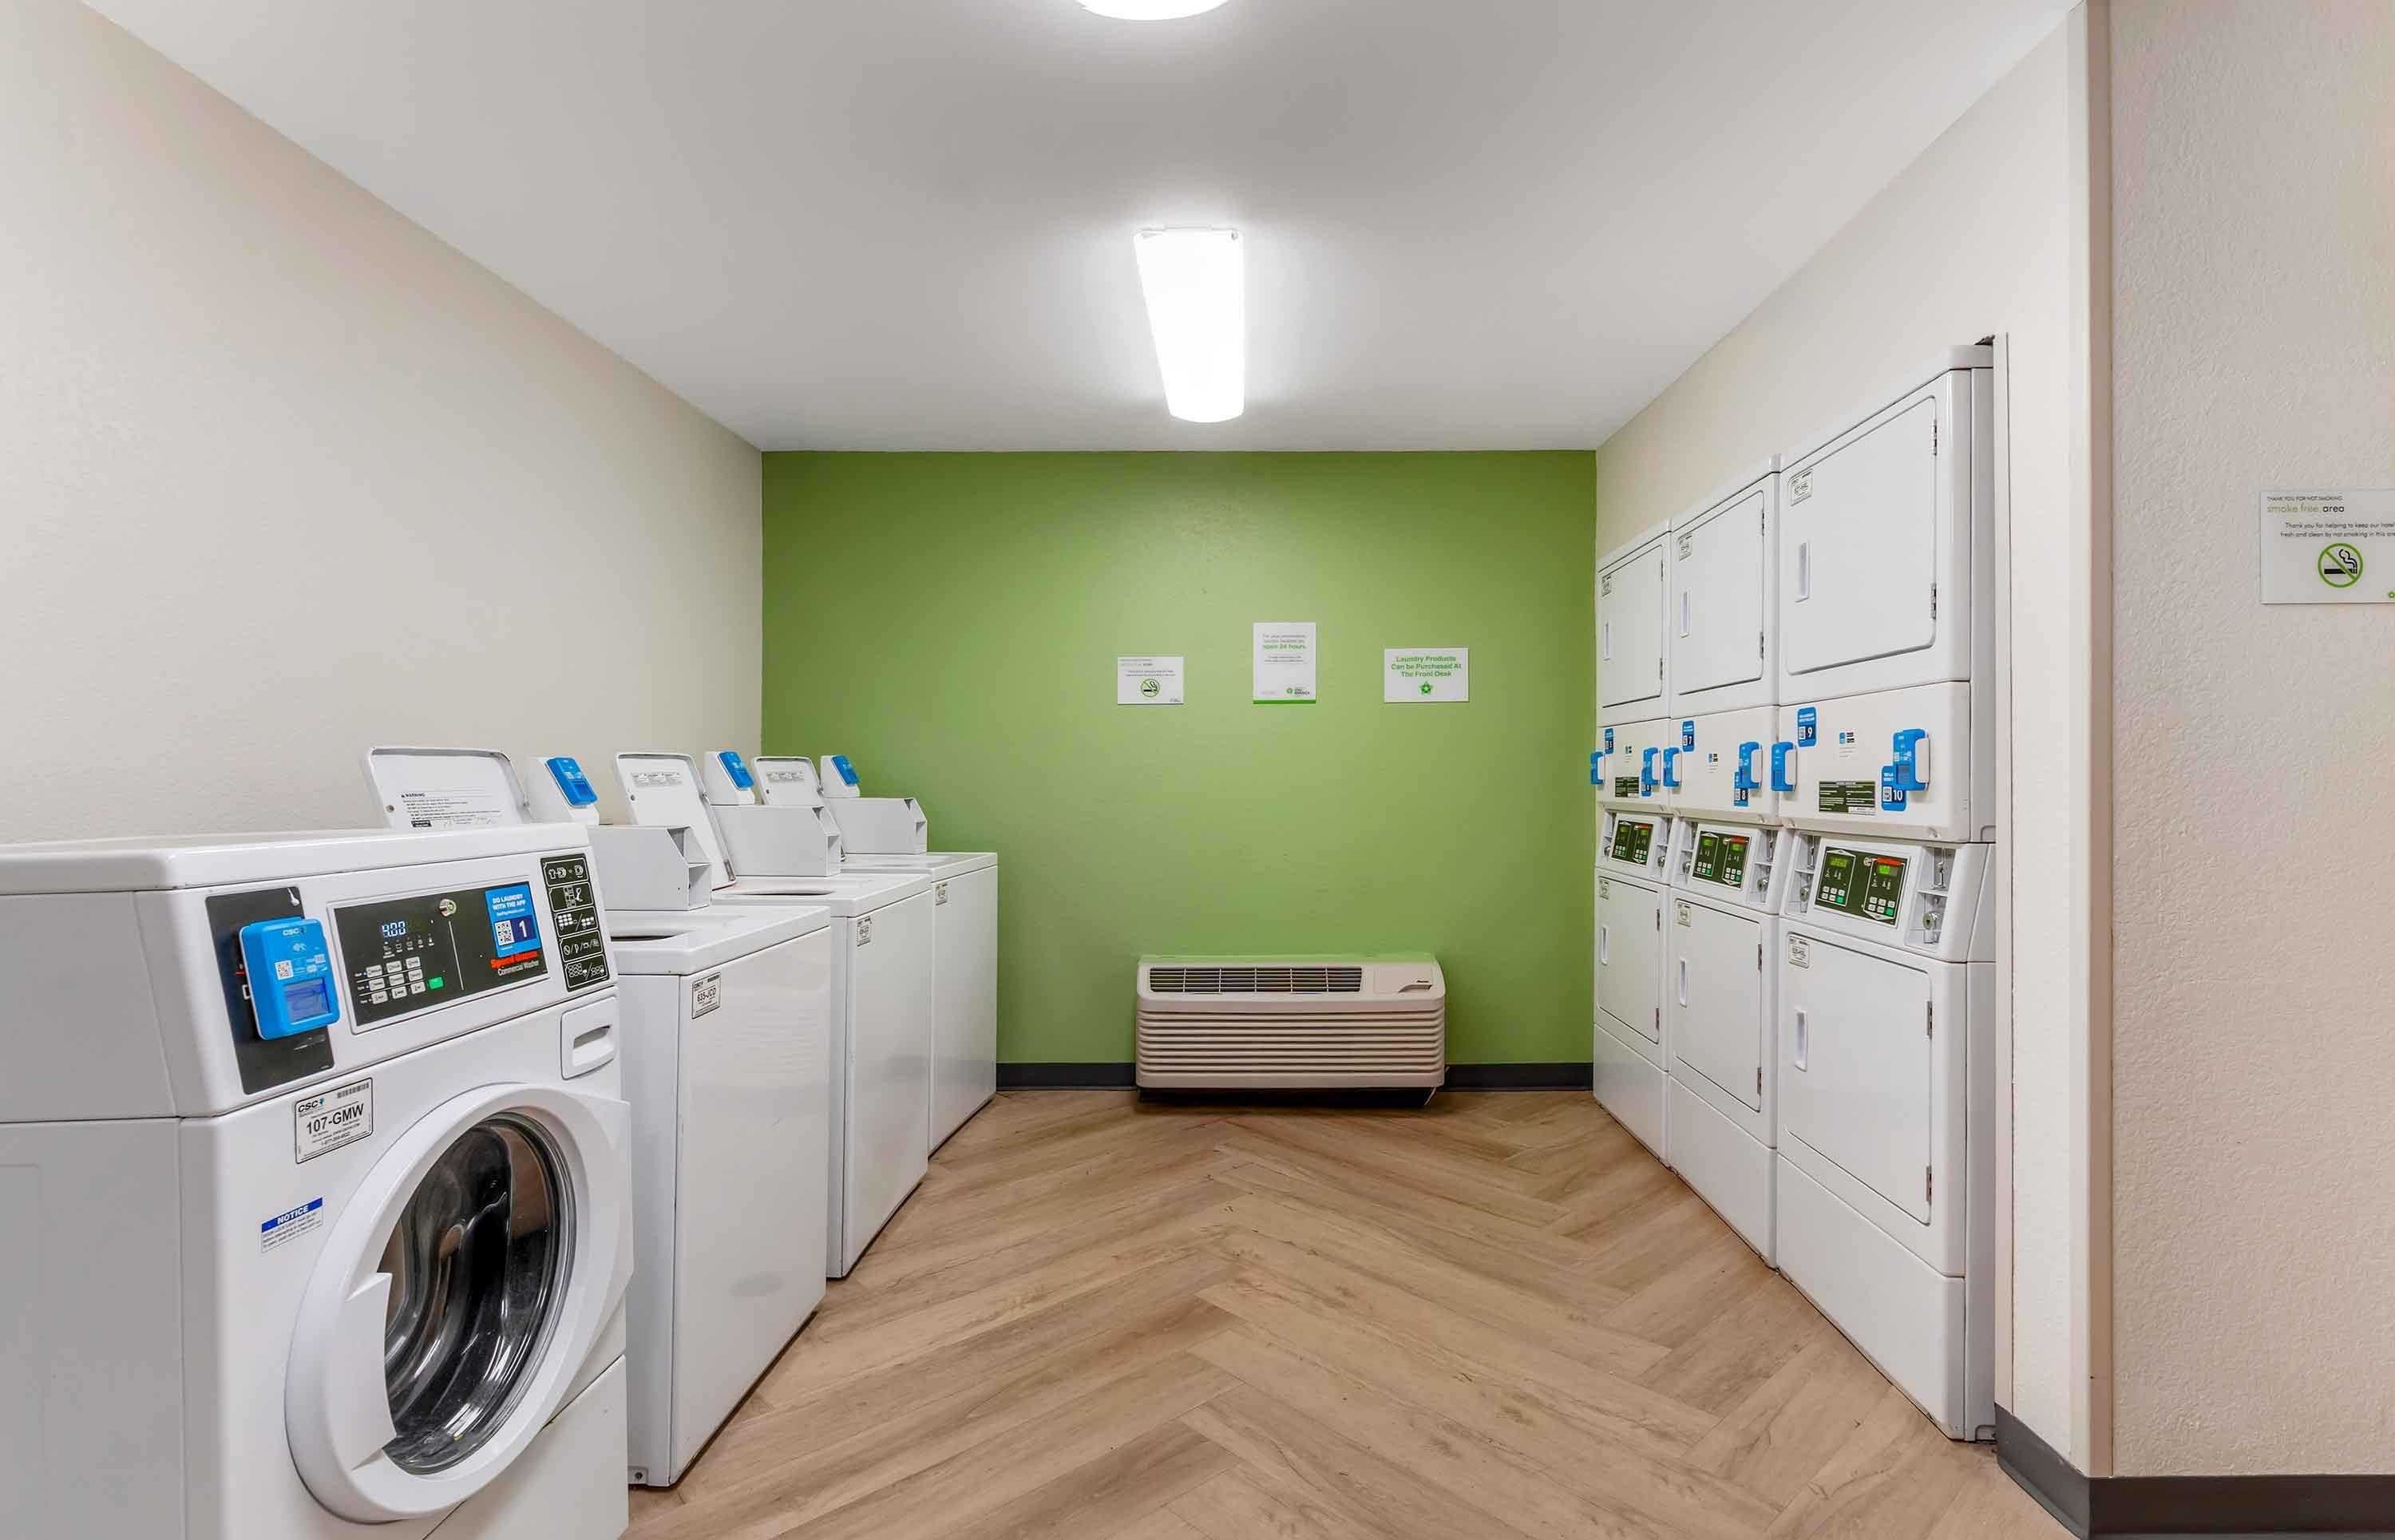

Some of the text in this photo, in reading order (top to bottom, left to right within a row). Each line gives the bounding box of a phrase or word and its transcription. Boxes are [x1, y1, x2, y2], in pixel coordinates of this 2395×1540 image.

[2267, 503, 2298, 513] smoke
[2301, 503, 2319, 513] free
[1807, 726, 1813, 738] 9
[1688, 735, 1693, 745] 7
[1741, 790, 1747, 801] 8
[1893, 790, 1903, 802] 10
[283, 928, 299, 936] CSC
[518, 920, 527, 938] 1
[298, 1100, 319, 1113] CSC
[307, 1103, 364, 1134] 107-GMW
[277, 1205, 309, 1225] NOTICE
